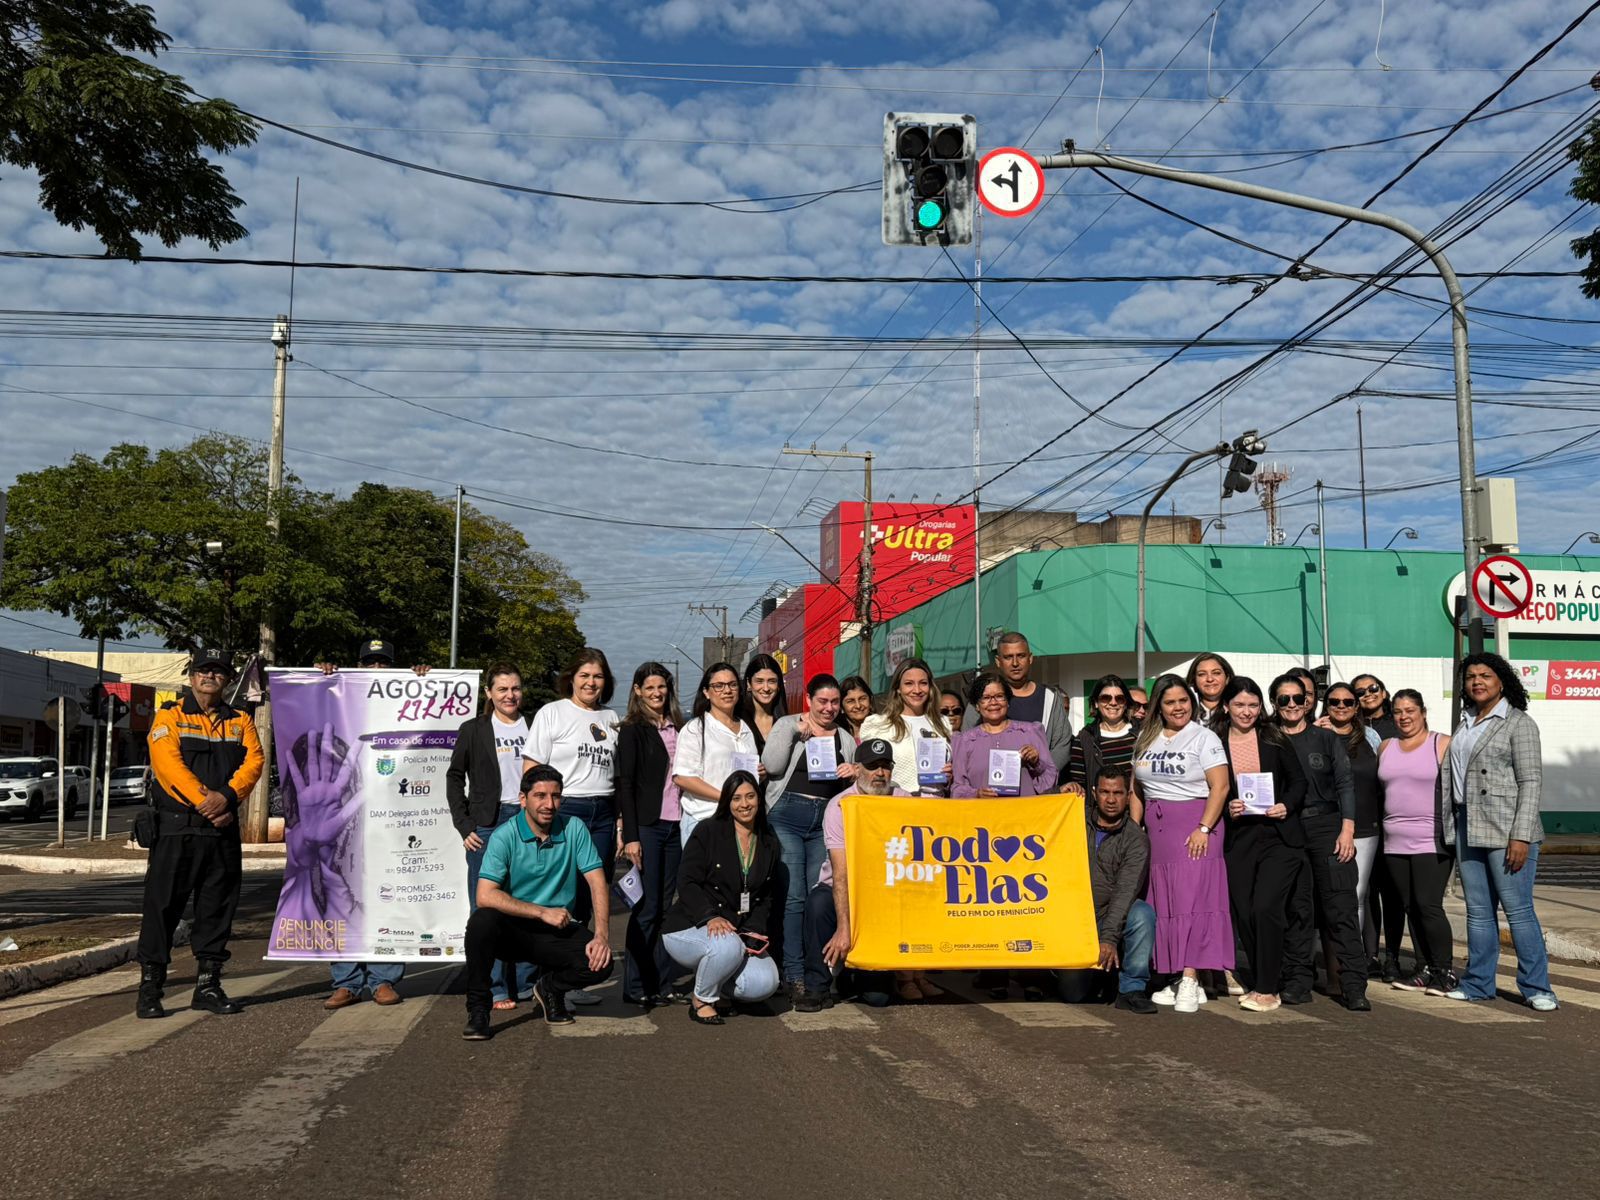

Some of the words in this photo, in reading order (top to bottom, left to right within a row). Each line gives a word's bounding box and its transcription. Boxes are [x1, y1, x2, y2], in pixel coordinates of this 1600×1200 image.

[919, 520, 956, 529] Drogarias
[884, 525, 954, 550] Ultra
[910, 551, 953, 563] Popular
[1564, 667, 1600, 680] 3441-
[367, 679, 471, 699] AGOSTO
[1565, 687, 1600, 697] 99920
[372, 736, 387, 745] Em
[388, 737, 409, 745] caso
[411, 736, 423, 745] de
[425, 735, 444, 744] risco
[446, 735, 457, 747] lig
[430, 755, 451, 763] Milita
[1151, 760, 1186, 775] Elas
[410, 785, 431, 795] 180
[388, 810, 419, 818] Delegacia
[430, 807, 450, 815] Mulhe
[396, 819, 437, 828] 3441-8261
[401, 856, 428, 865] Cram:
[396, 864, 445, 874] 98427-5293
[885, 862, 943, 887] por
[942, 864, 1049, 905] Elas
[407, 891, 456, 902] 99262-3462
[982, 909, 995, 917] DO
[997, 906, 1045, 917] FEMINICÍDIO
[280, 918, 346, 931] DENUNCIE
[276, 938, 346, 950] DENUNCIE
